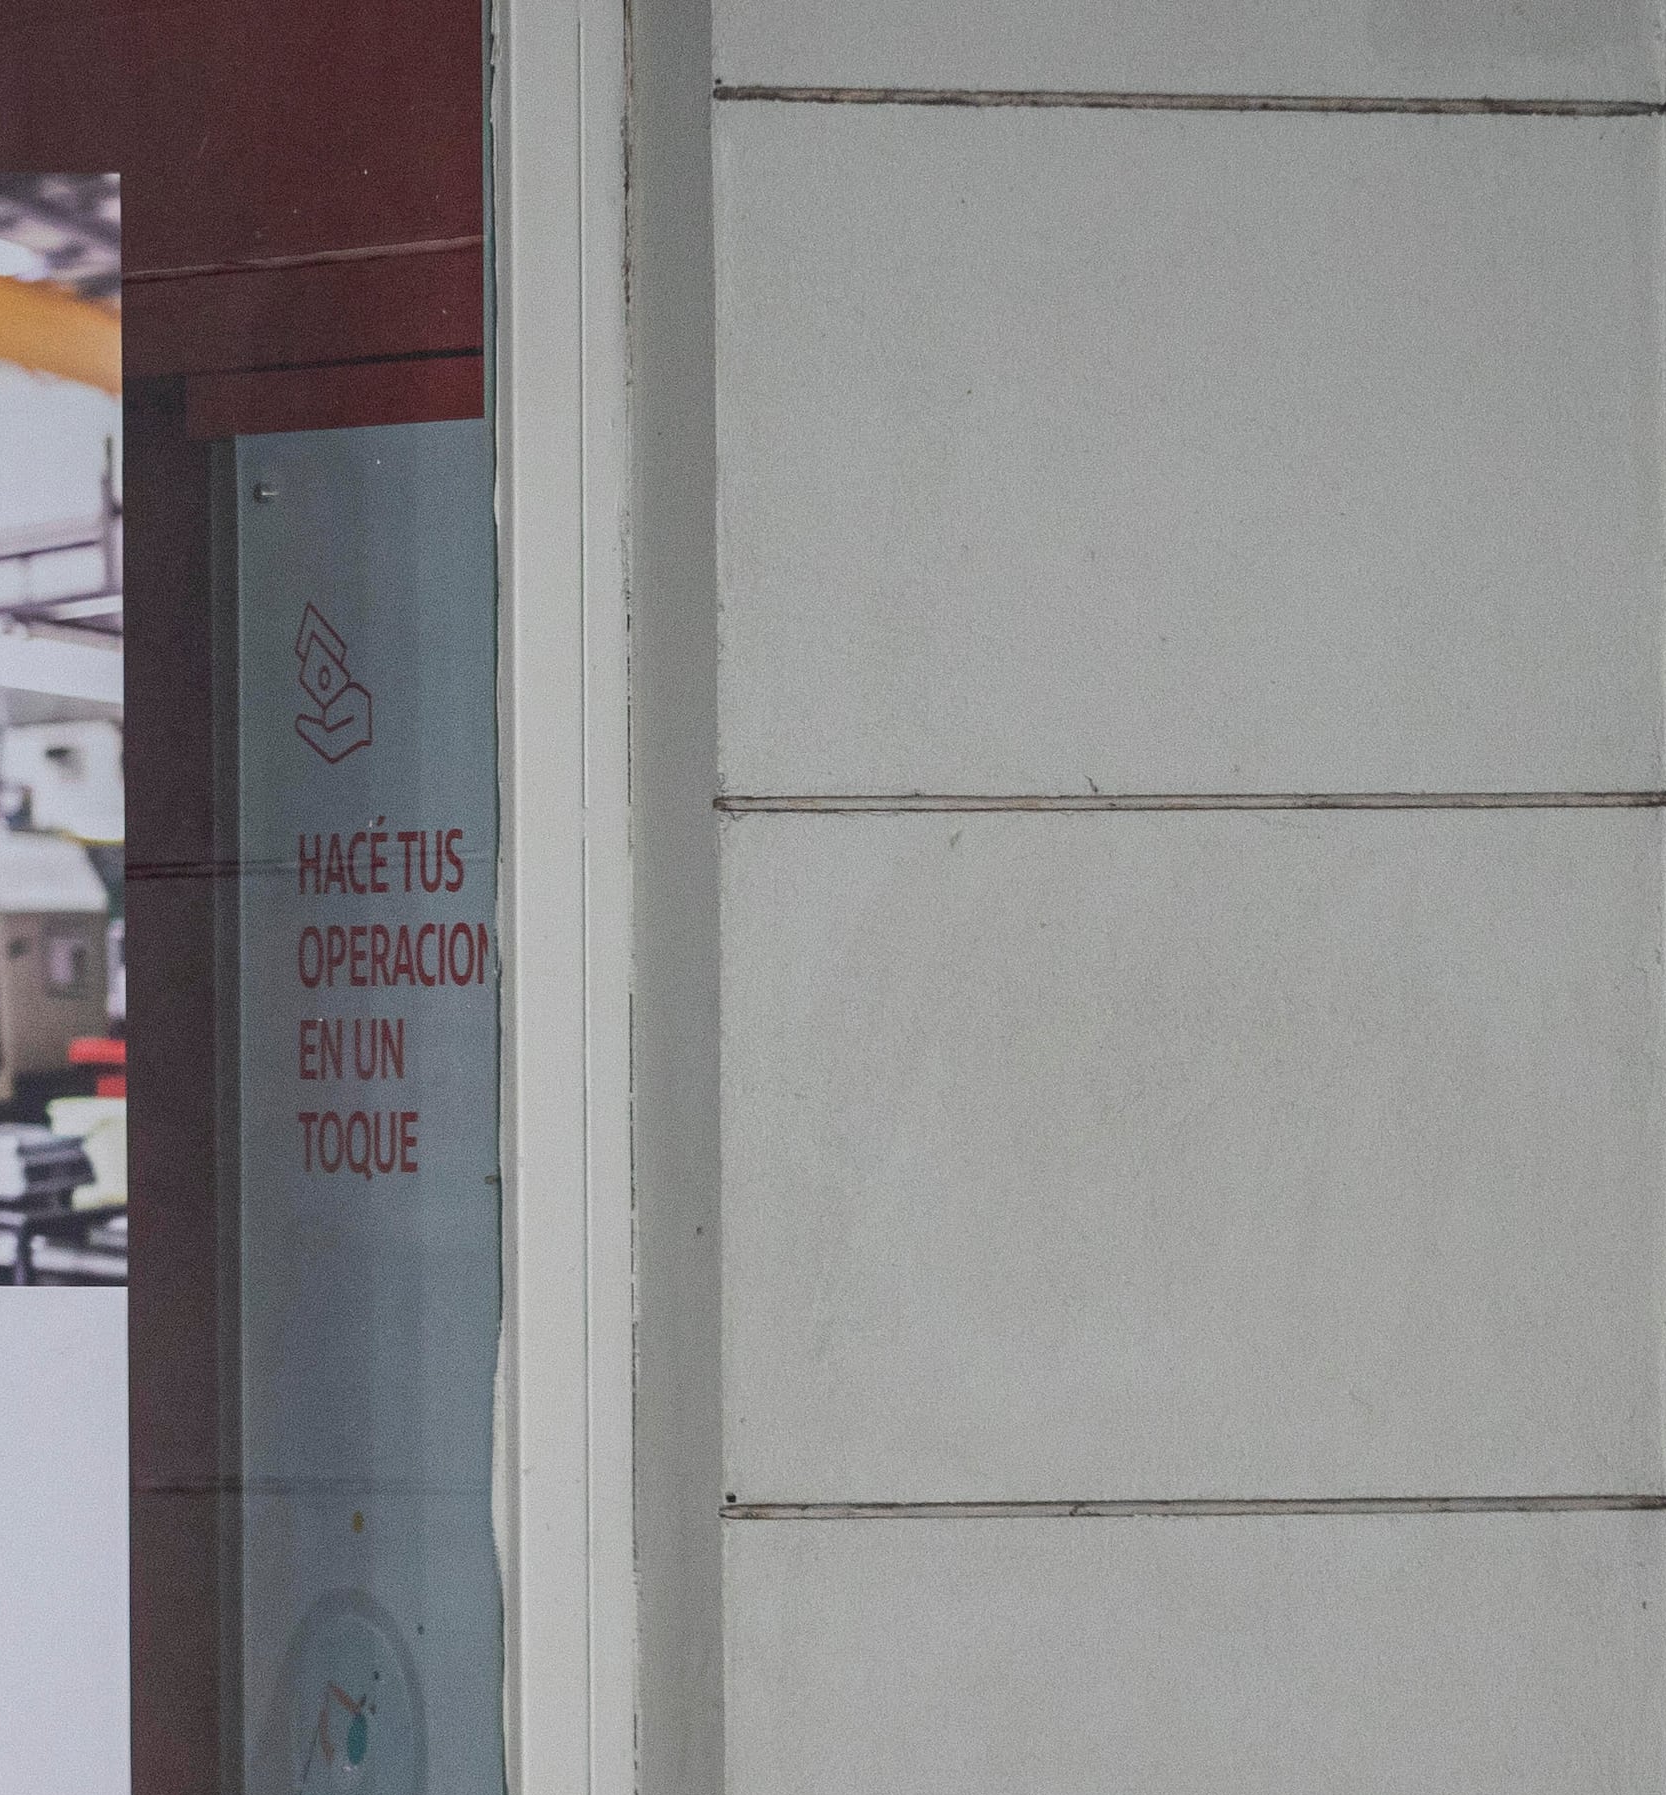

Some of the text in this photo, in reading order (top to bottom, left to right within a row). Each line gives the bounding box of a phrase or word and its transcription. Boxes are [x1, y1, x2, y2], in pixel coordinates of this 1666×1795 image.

[298, 815, 464, 895] HACÉ TUS
[300, 1019, 404, 1080] EN UN
[298, 1111, 418, 1180] TOQUE
